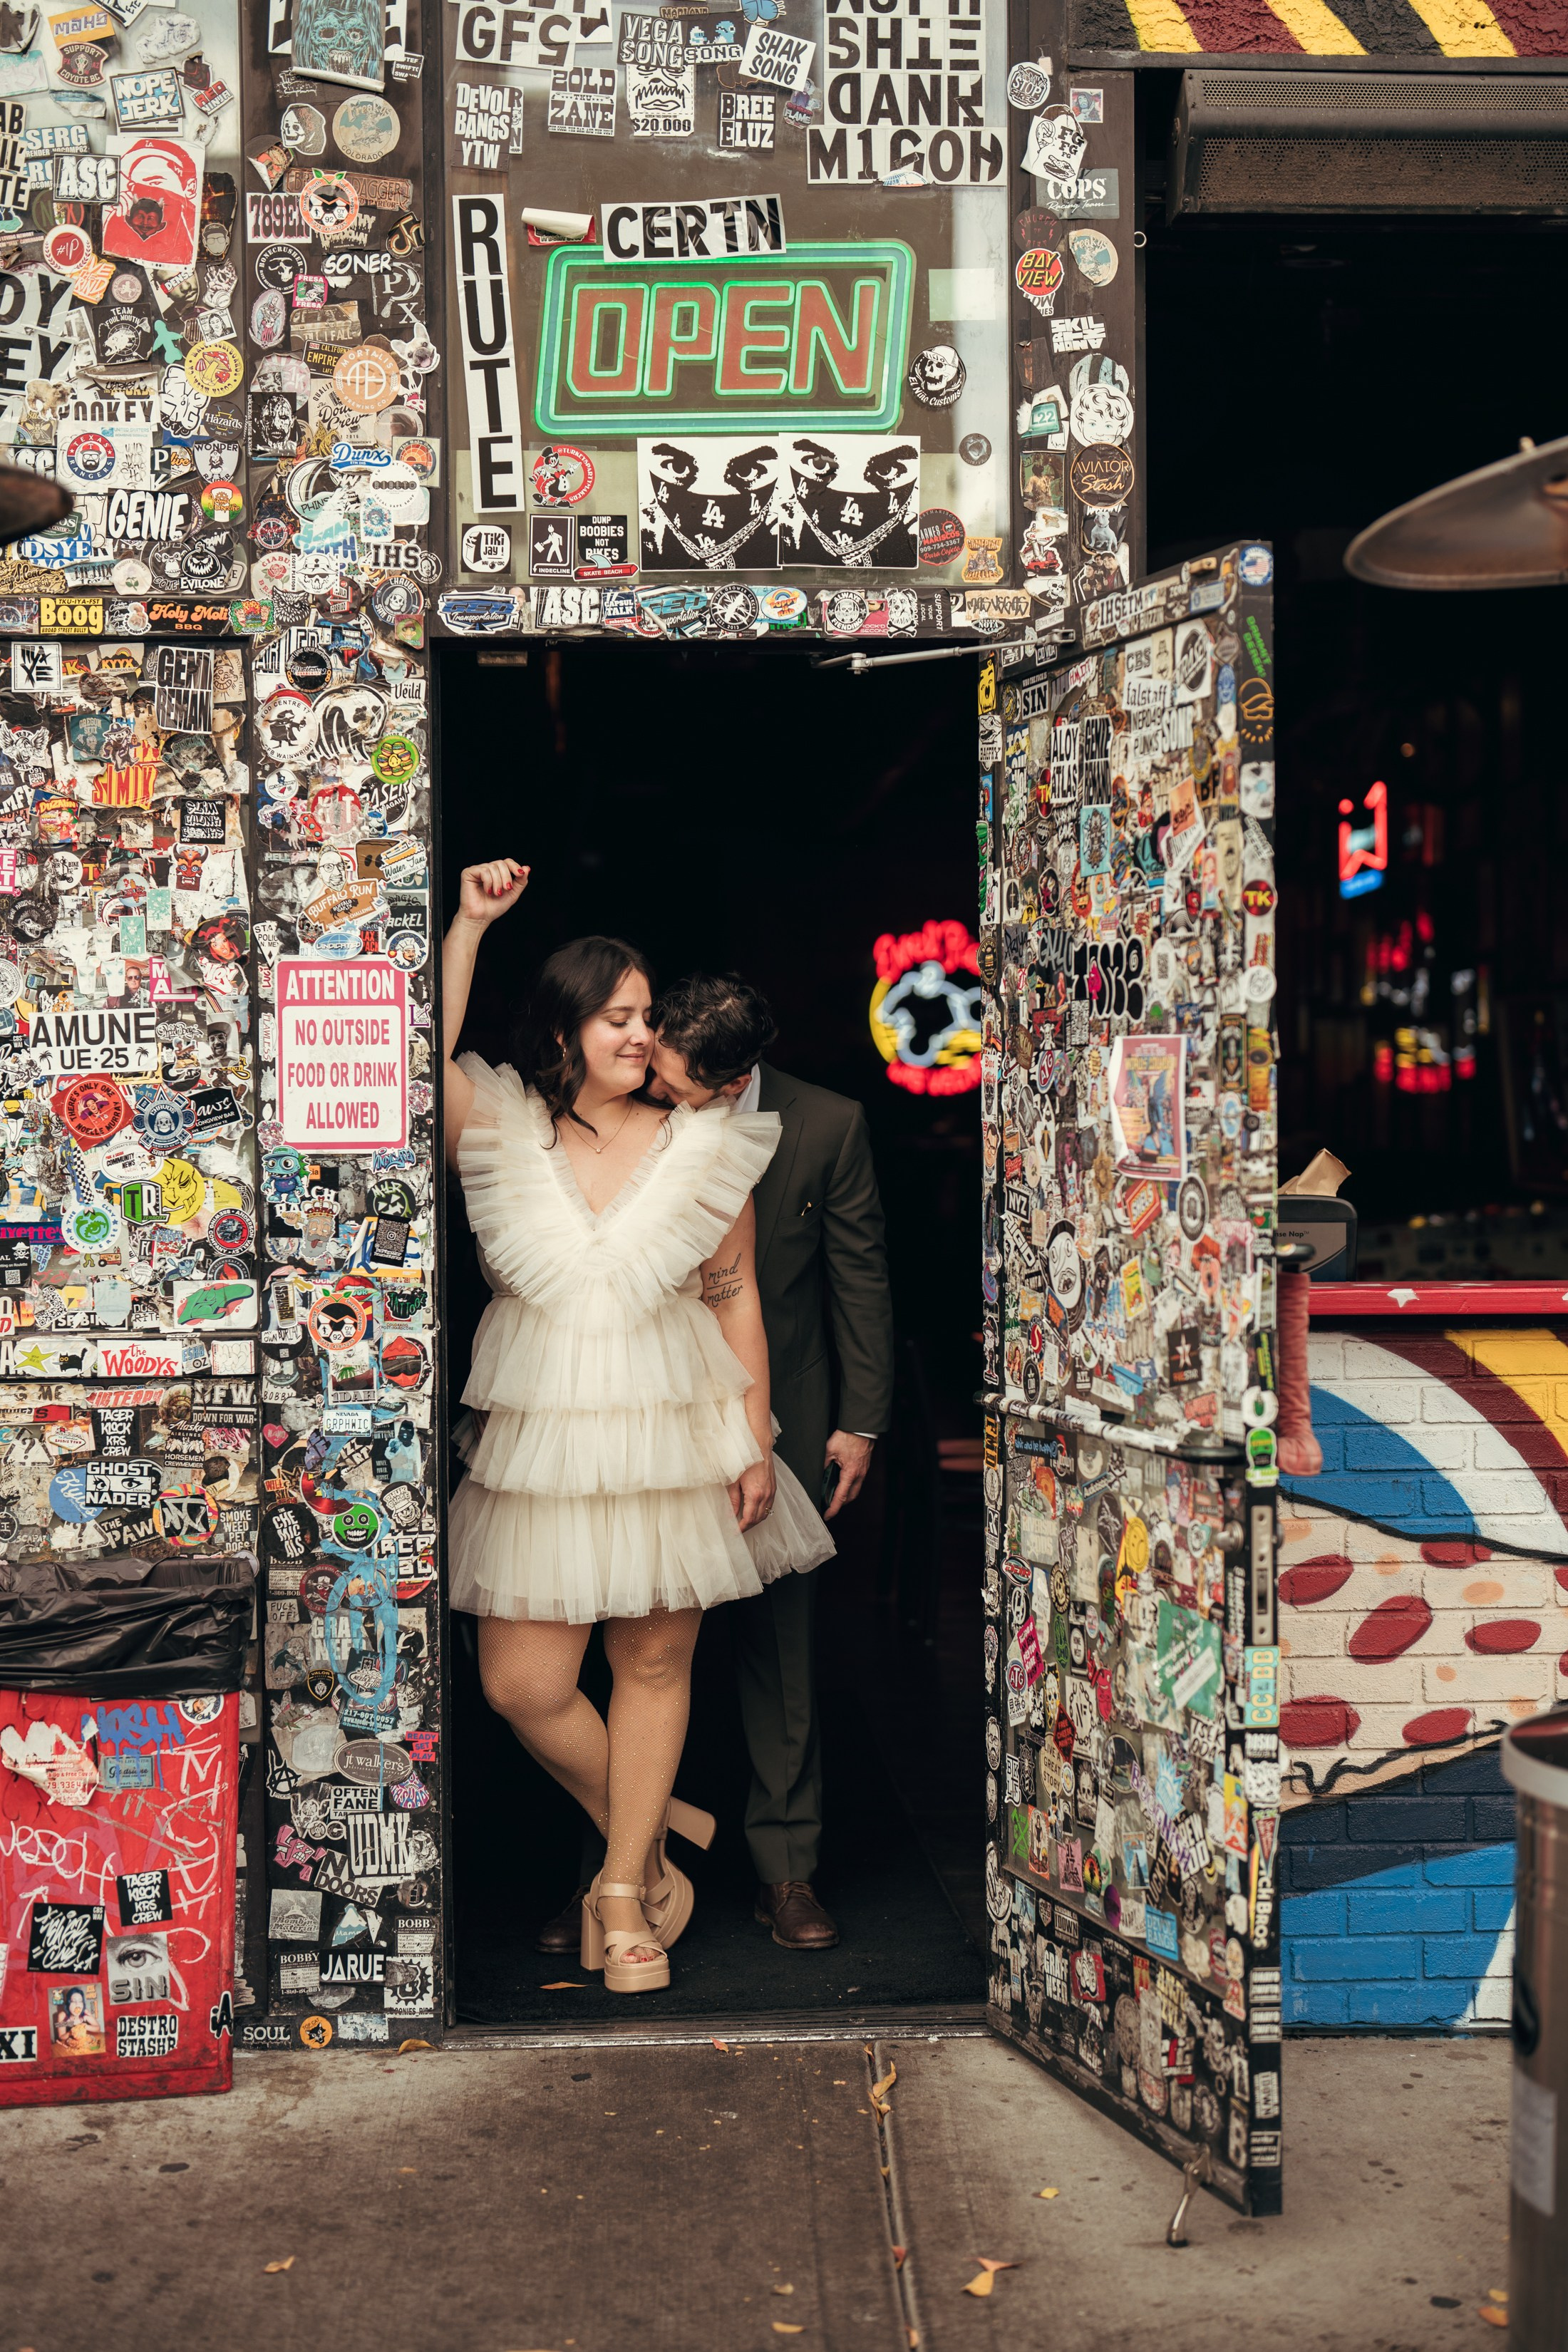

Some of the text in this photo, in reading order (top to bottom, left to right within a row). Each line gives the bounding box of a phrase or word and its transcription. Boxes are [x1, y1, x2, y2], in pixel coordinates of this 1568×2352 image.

[624, 14, 683, 44] VEGA
[63, 45, 101, 58] SUPPORT
[620, 40, 683, 70] SONG
[684, 44, 743, 64] SONG
[755, 31, 808, 65] SHAK
[60, 70, 100, 83] COYOTE BC
[749, 55, 798, 86] SONG
[115, 72, 175, 100] NOPE
[457, 83, 512, 115] DEVOL
[721, 93, 775, 120] BREE
[120, 95, 180, 122] JERK
[550, 100, 615, 130] ZANE
[785, 109, 812, 124] FLAME
[455, 110, 510, 141] BANGS
[720, 121, 775, 148] ELUZ
[25, 125, 87, 150] SERG
[1058, 125, 1084, 148] FG
[341, 145, 383, 161] COLORADO
[462, 140, 500, 169] YTW
[1059, 142, 1078, 156] FG
[1047, 178, 1107, 200] COPS
[1046, 200, 1116, 212] Racing Team
[259, 246, 304, 269] BONECRUSHER
[324, 253, 392, 275] SONER
[1022, 253, 1057, 269] BAY
[1018, 269, 1061, 287] VIEW
[110, 306, 133, 315] TEAM
[105, 314, 140, 326] FOUL MOUTH
[567, 279, 882, 398] OPEN
[307, 352, 339, 366] EMPIRE
[341, 349, 393, 369] MORTALIS
[909, 376, 917, 391] El
[929, 390, 963, 406] Customs
[344, 396, 375, 409] BREWING
[205, 411, 243, 429] Hazards
[73, 435, 108, 448] TEXAS
[194, 443, 238, 453] WONDER
[69, 460, 113, 479] RANGERS
[372, 480, 418, 490] RIALTO
[1080, 476, 1125, 492] Stash
[109, 489, 190, 541] GENIE
[702, 500, 726, 528] LA
[840, 496, 864, 526] LA
[592, 516, 612, 525] DUMP
[580, 526, 624, 537] BOOBIES
[923, 531, 961, 546] MARISCOS
[594, 538, 609, 547] NOT
[919, 538, 961, 554] 909-734-3367
[373, 544, 420, 568] IHS
[180, 578, 225, 589] EVILONE
[832, 591, 862, 604] ALWAYS
[41, 597, 103, 634] Boog
[149, 604, 190, 622] Holy
[451, 611, 505, 621] Transportation
[607, 606, 634, 616] TALK
[934, 593, 944, 631] SUPPORT
[831, 616, 865, 631] FIENDING
[102, 658, 135, 669] KYYX
[1023, 686, 1048, 718] SIN
[1127, 683, 1167, 707] falstaff
[261, 706, 272, 719] EOD
[277, 738, 315, 759] WAINWRIGHT
[385, 863, 407, 877] Water
[308, 881, 375, 919] BUFFALO RUN
[1246, 891, 1272, 907] TK
[286, 969, 395, 1000] ATTENTION
[31, 1011, 156, 1048] AMUNE
[295, 1018, 390, 1046] NO OUTSIDE
[287, 1062, 398, 1088] FOOD OR DRINK
[66, 1082, 115, 1121] THERE'S ONLY ONE
[76, 1101, 121, 1136] NOELLE MURRAY
[195, 1111, 235, 1128] LONGVIEW BAR
[306, 1102, 380, 1129] ALLOWED
[106, 1152, 135, 1167] COMMUNITY
[122, 1160, 136, 1170] NEWS
[1009, 1192, 1028, 1216] NYZ
[708, 1252, 741, 1284] mind
[707, 1284, 743, 1308] matter
[129, 1343, 147, 1357] the
[101, 1349, 178, 1377] WOODYS
[98, 1408, 135, 1422] TAGER
[193, 1413, 254, 1423] DOWN FOR WAR
[169, 1419, 206, 1432] Alaska
[106, 1435, 127, 1446] KRS
[102, 1445, 131, 1457] CREW
[165, 1453, 205, 1462] HORSEMEN
[87, 1463, 153, 1475] GHOST
[86, 1492, 151, 1505] NADER
[102, 1517, 122, 1531] THE
[220, 1509, 252, 1522] SMOKE
[223, 1520, 250, 1533] WEED
[229, 1531, 246, 1543] PET
[270, 1602, 296, 1612] FUCK
[1010, 1666, 1024, 1688] ATG
[1044, 1744, 1056, 1758] LIVE
[356, 1754, 404, 1772] walker's
[1043, 1756, 1061, 1775] GREAT
[1043, 1773, 1060, 1792] STORY
[333, 1788, 378, 1798] OFTEN
[333, 1798, 378, 1810] FANE
[122, 1870, 162, 1889] TAGER
[314, 1870, 379, 1907] DOORS
[135, 1899, 157, 1912] KRS
[132, 1911, 163, 1924] CREW
[280, 1951, 320, 1964] BOBBY
[321, 1954, 385, 1981] JARUE
[110, 1975, 169, 2003] SIN
[118, 2015, 177, 2037] DESTRO
[243, 2026, 291, 2043] SOUL
